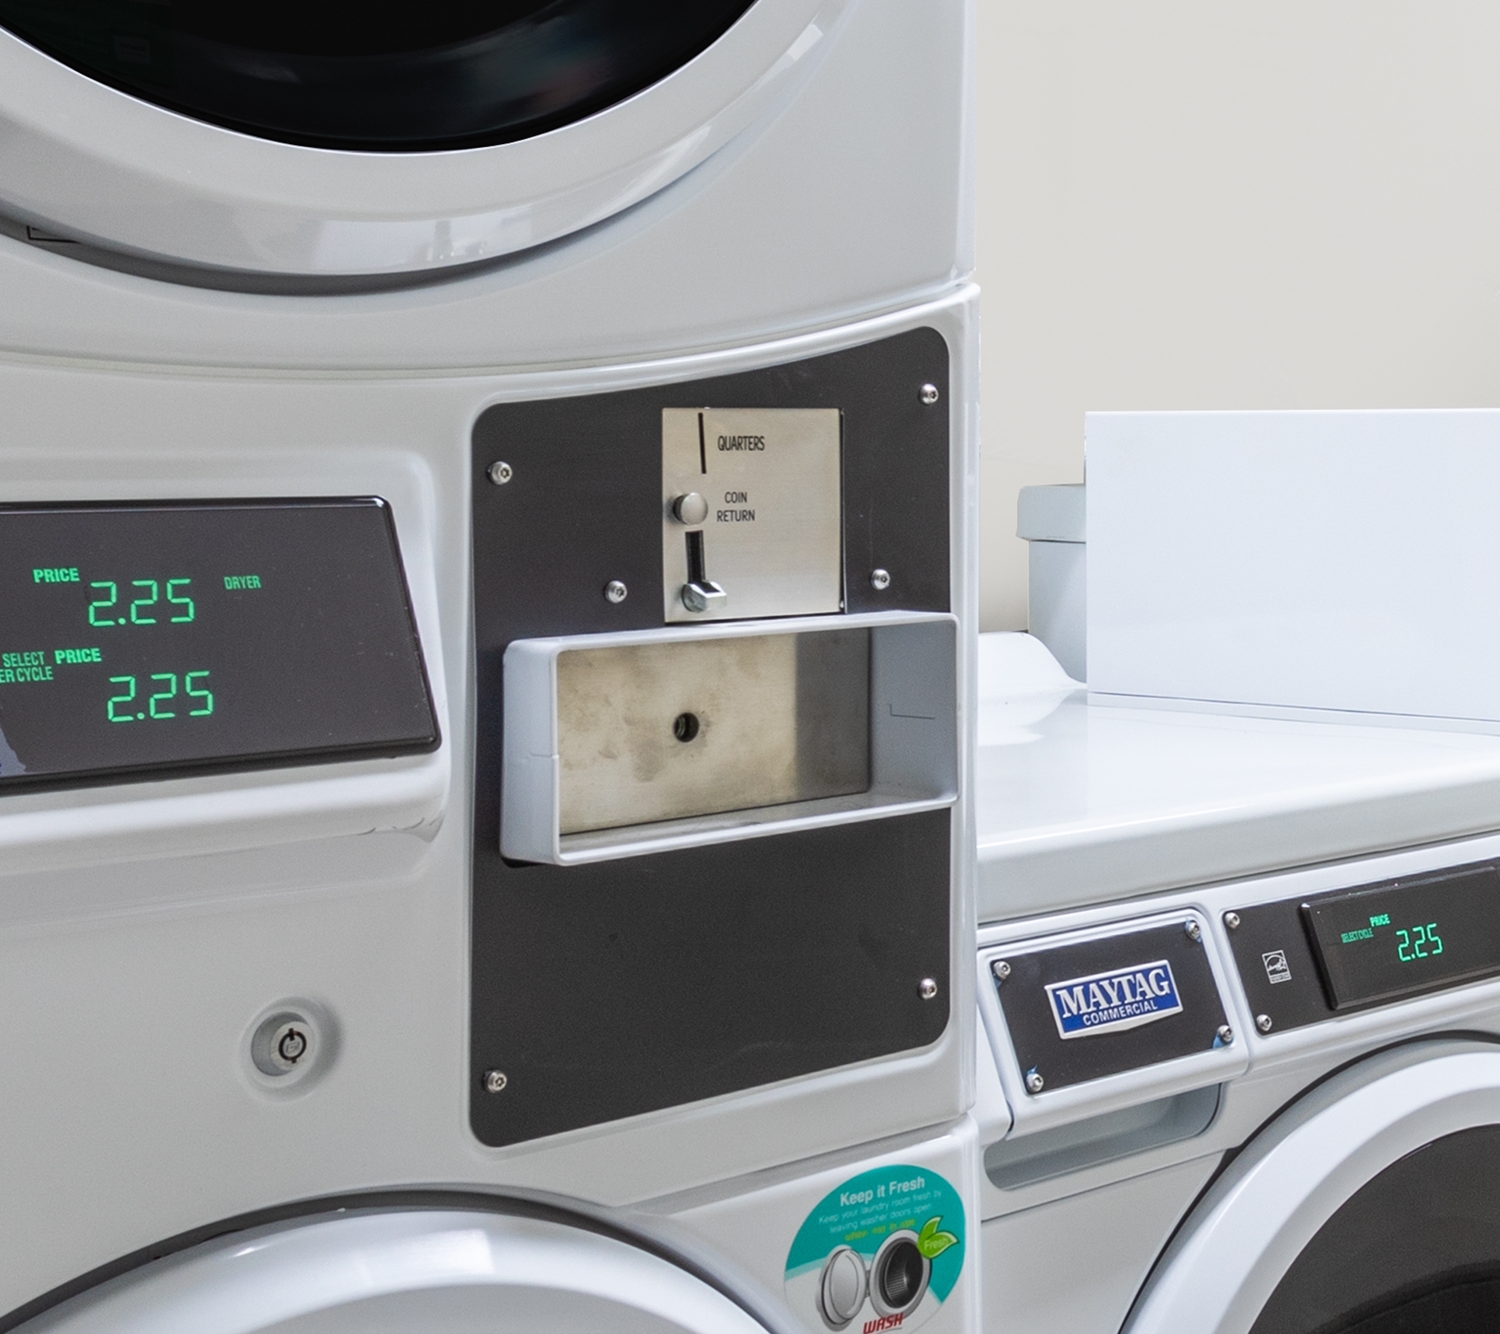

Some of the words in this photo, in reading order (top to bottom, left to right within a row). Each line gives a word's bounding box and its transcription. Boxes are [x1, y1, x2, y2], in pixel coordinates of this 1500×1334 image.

[717, 435, 766, 451] QUARTERS
[724, 491, 748, 504] COIN
[716, 509, 756, 522] RETURN
[32, 568, 80, 585] PRICE
[88, 578, 195, 627] 2.25
[224, 575, 261, 591] DRYER
[2, 651, 45, 667] SELECT
[54, 648, 102, 664] PRICE
[16, 666, 54, 683] CYCLE
[107, 670, 214, 723] 2.25
[1369, 913, 1391, 927] PRICE
[1395, 923, 1443, 962] 2.25
[1055, 968, 1171, 1019] MAYTAG
[1082, 999, 1158, 1026] COMMERCIAL
[840, 1189, 874, 1207] Keep
[877, 1184, 885, 1198] it
[889, 1176, 925, 1196] Fresh
[923, 1236, 949, 1251] Fresh
[862, 1312, 904, 1334] WASH
